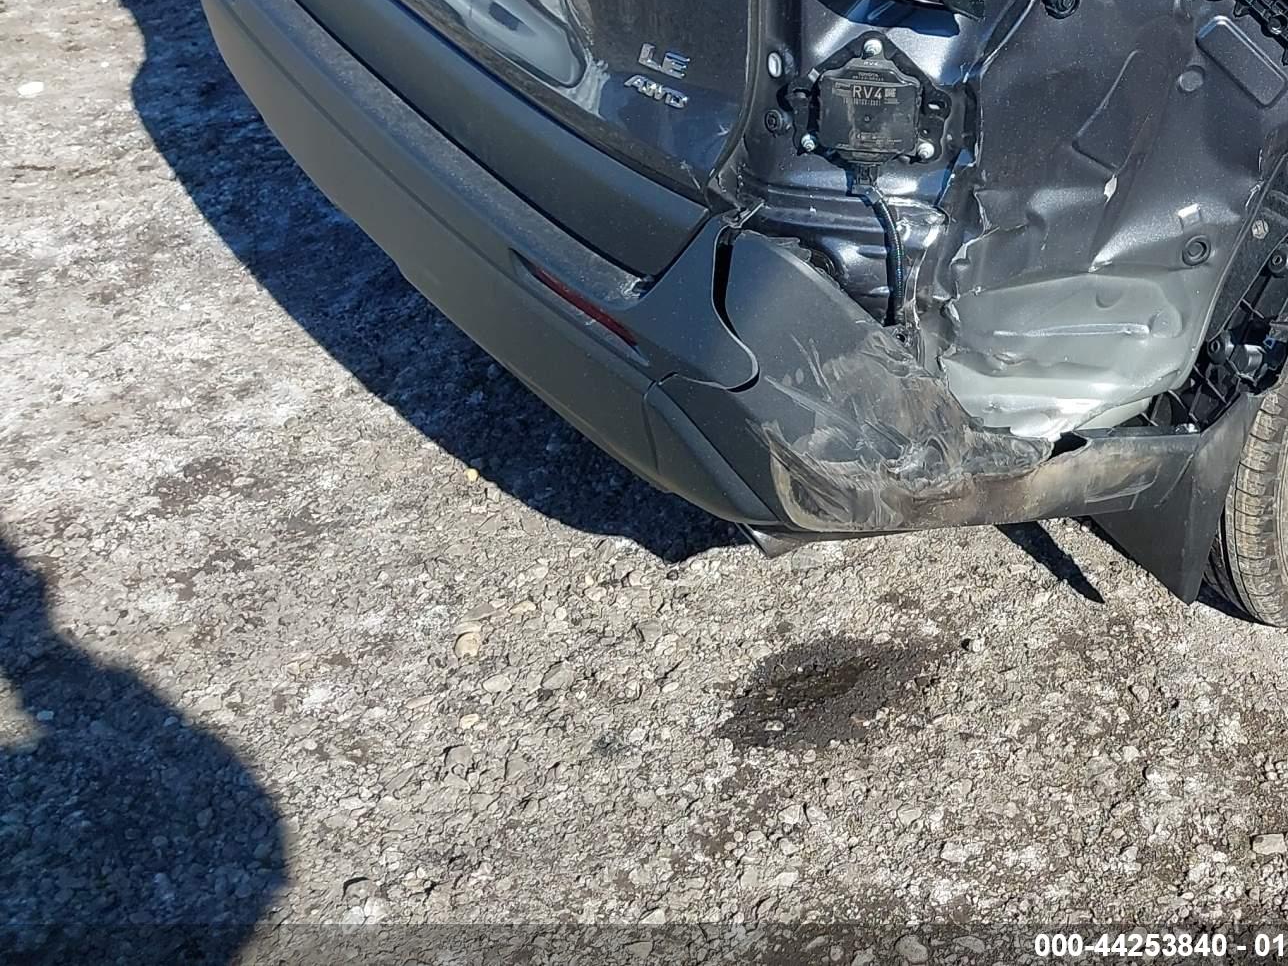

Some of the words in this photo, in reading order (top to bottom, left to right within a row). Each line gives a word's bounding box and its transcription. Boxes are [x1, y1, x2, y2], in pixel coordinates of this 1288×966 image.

[638, 43, 691, 80] LE
[623, 74, 689, 109] AWD
[852, 85, 882, 99] RV4
